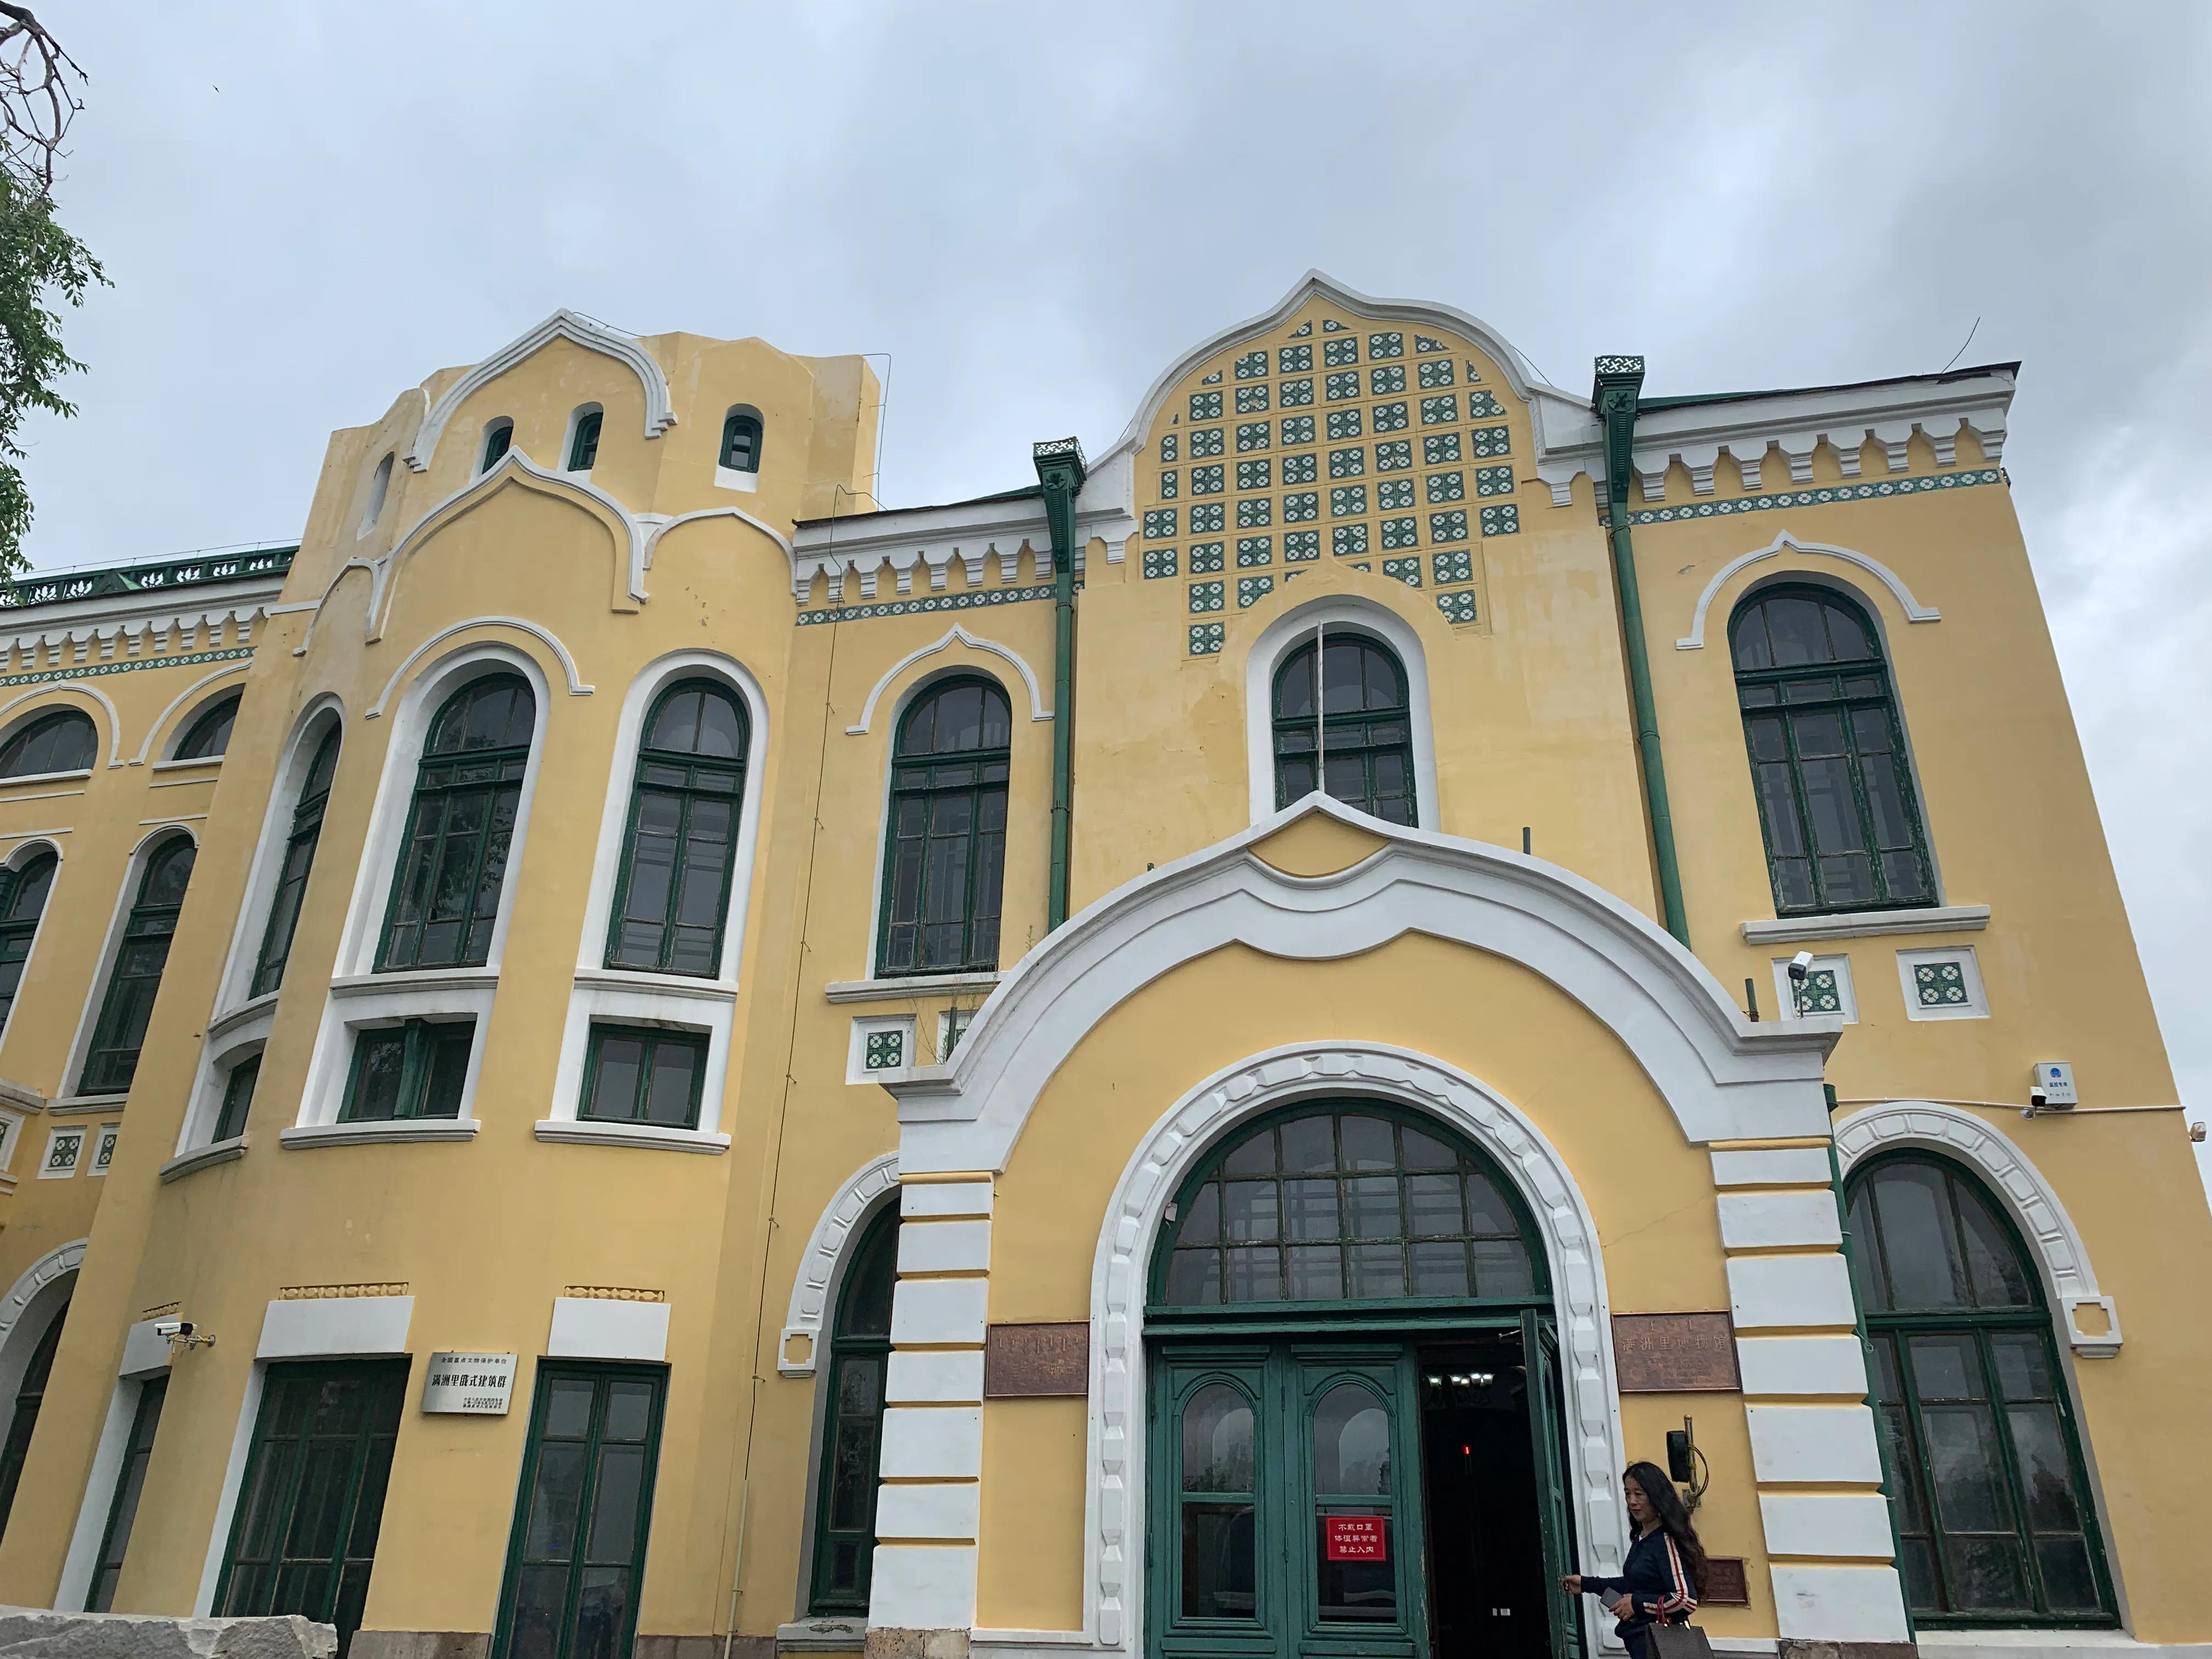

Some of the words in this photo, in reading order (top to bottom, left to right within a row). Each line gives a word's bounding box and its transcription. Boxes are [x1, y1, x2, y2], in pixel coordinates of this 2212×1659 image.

[1622, 1334, 1726, 1352] 满洲里博物馆
[432, 1374, 507, 1388] 满洲里俄式建筑群
